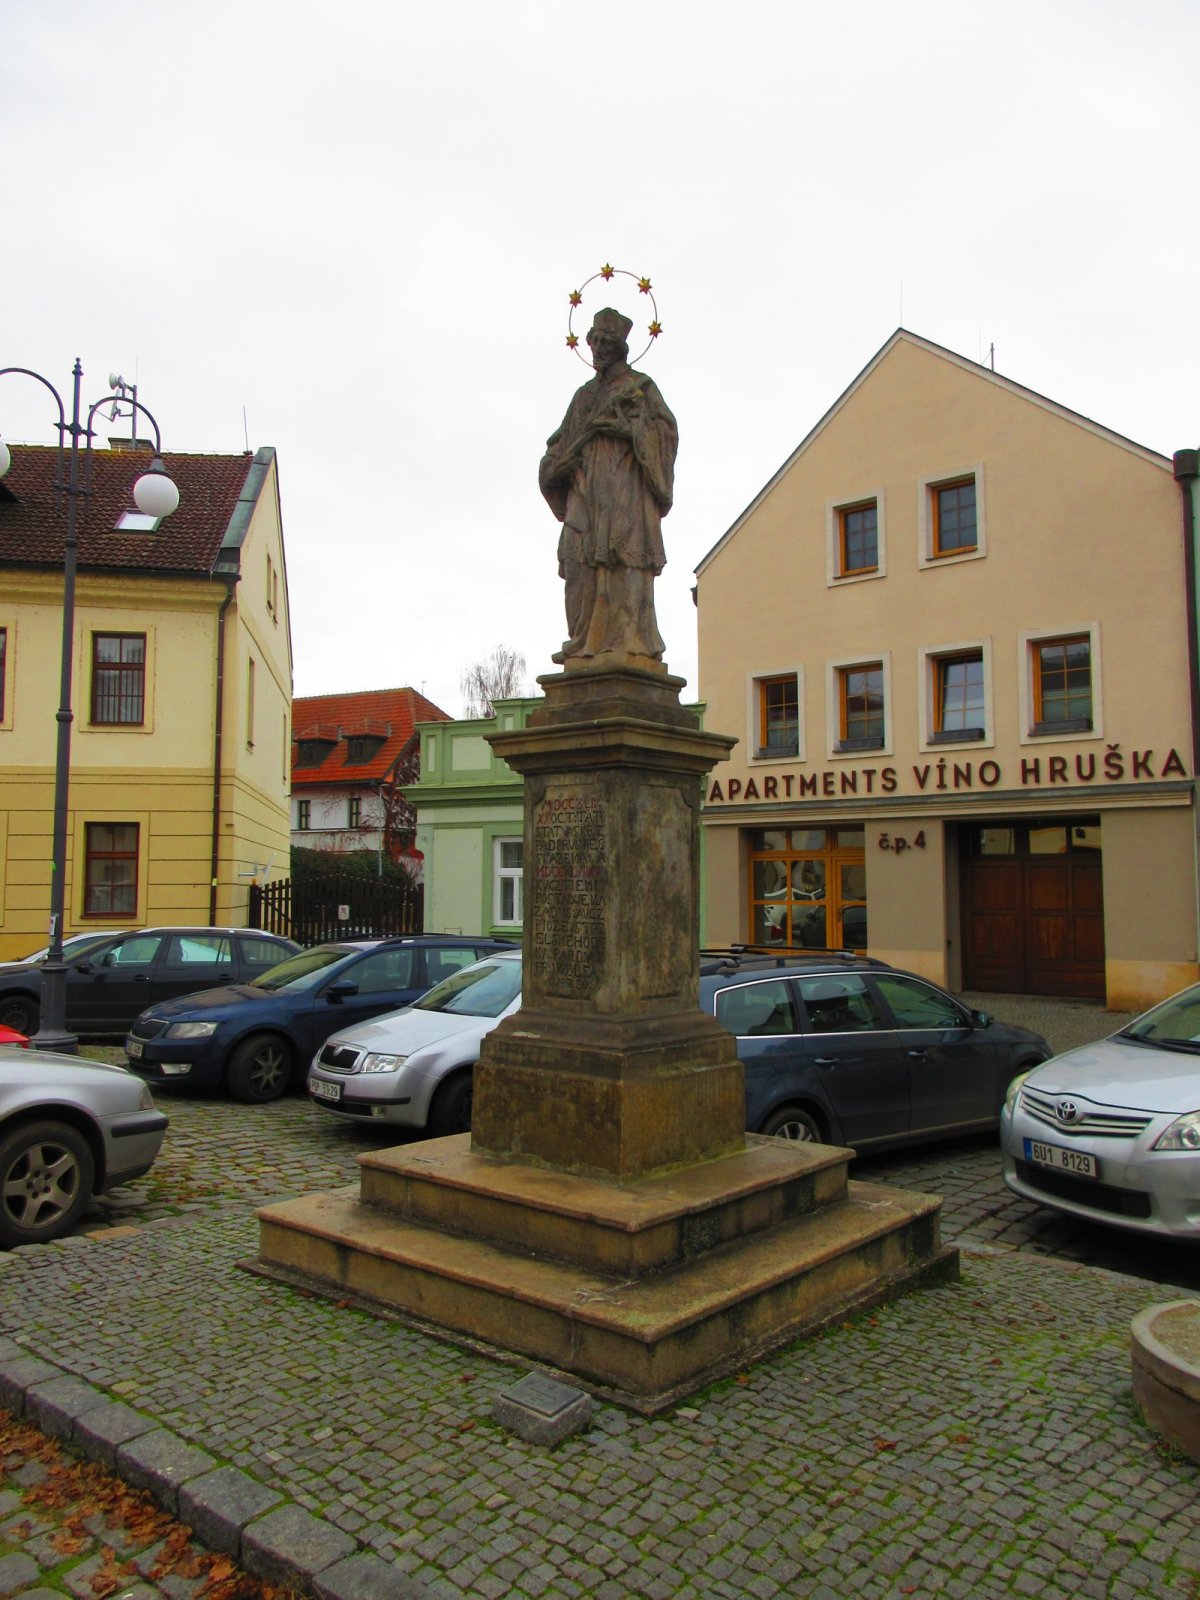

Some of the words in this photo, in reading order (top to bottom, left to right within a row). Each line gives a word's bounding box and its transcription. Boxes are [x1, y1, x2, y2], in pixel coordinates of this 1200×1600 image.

[709, 767, 897, 801] APARTMENTS
[913, 757, 1001, 789] VÍNO
[1021, 744, 1187, 784] HRUŠKA
[879, 833, 911, 854] č.p.
[914, 830, 926, 849] 4
[1033, 1144, 1054, 1163] 6U1
[1061, 1151, 1091, 1173] 8129
